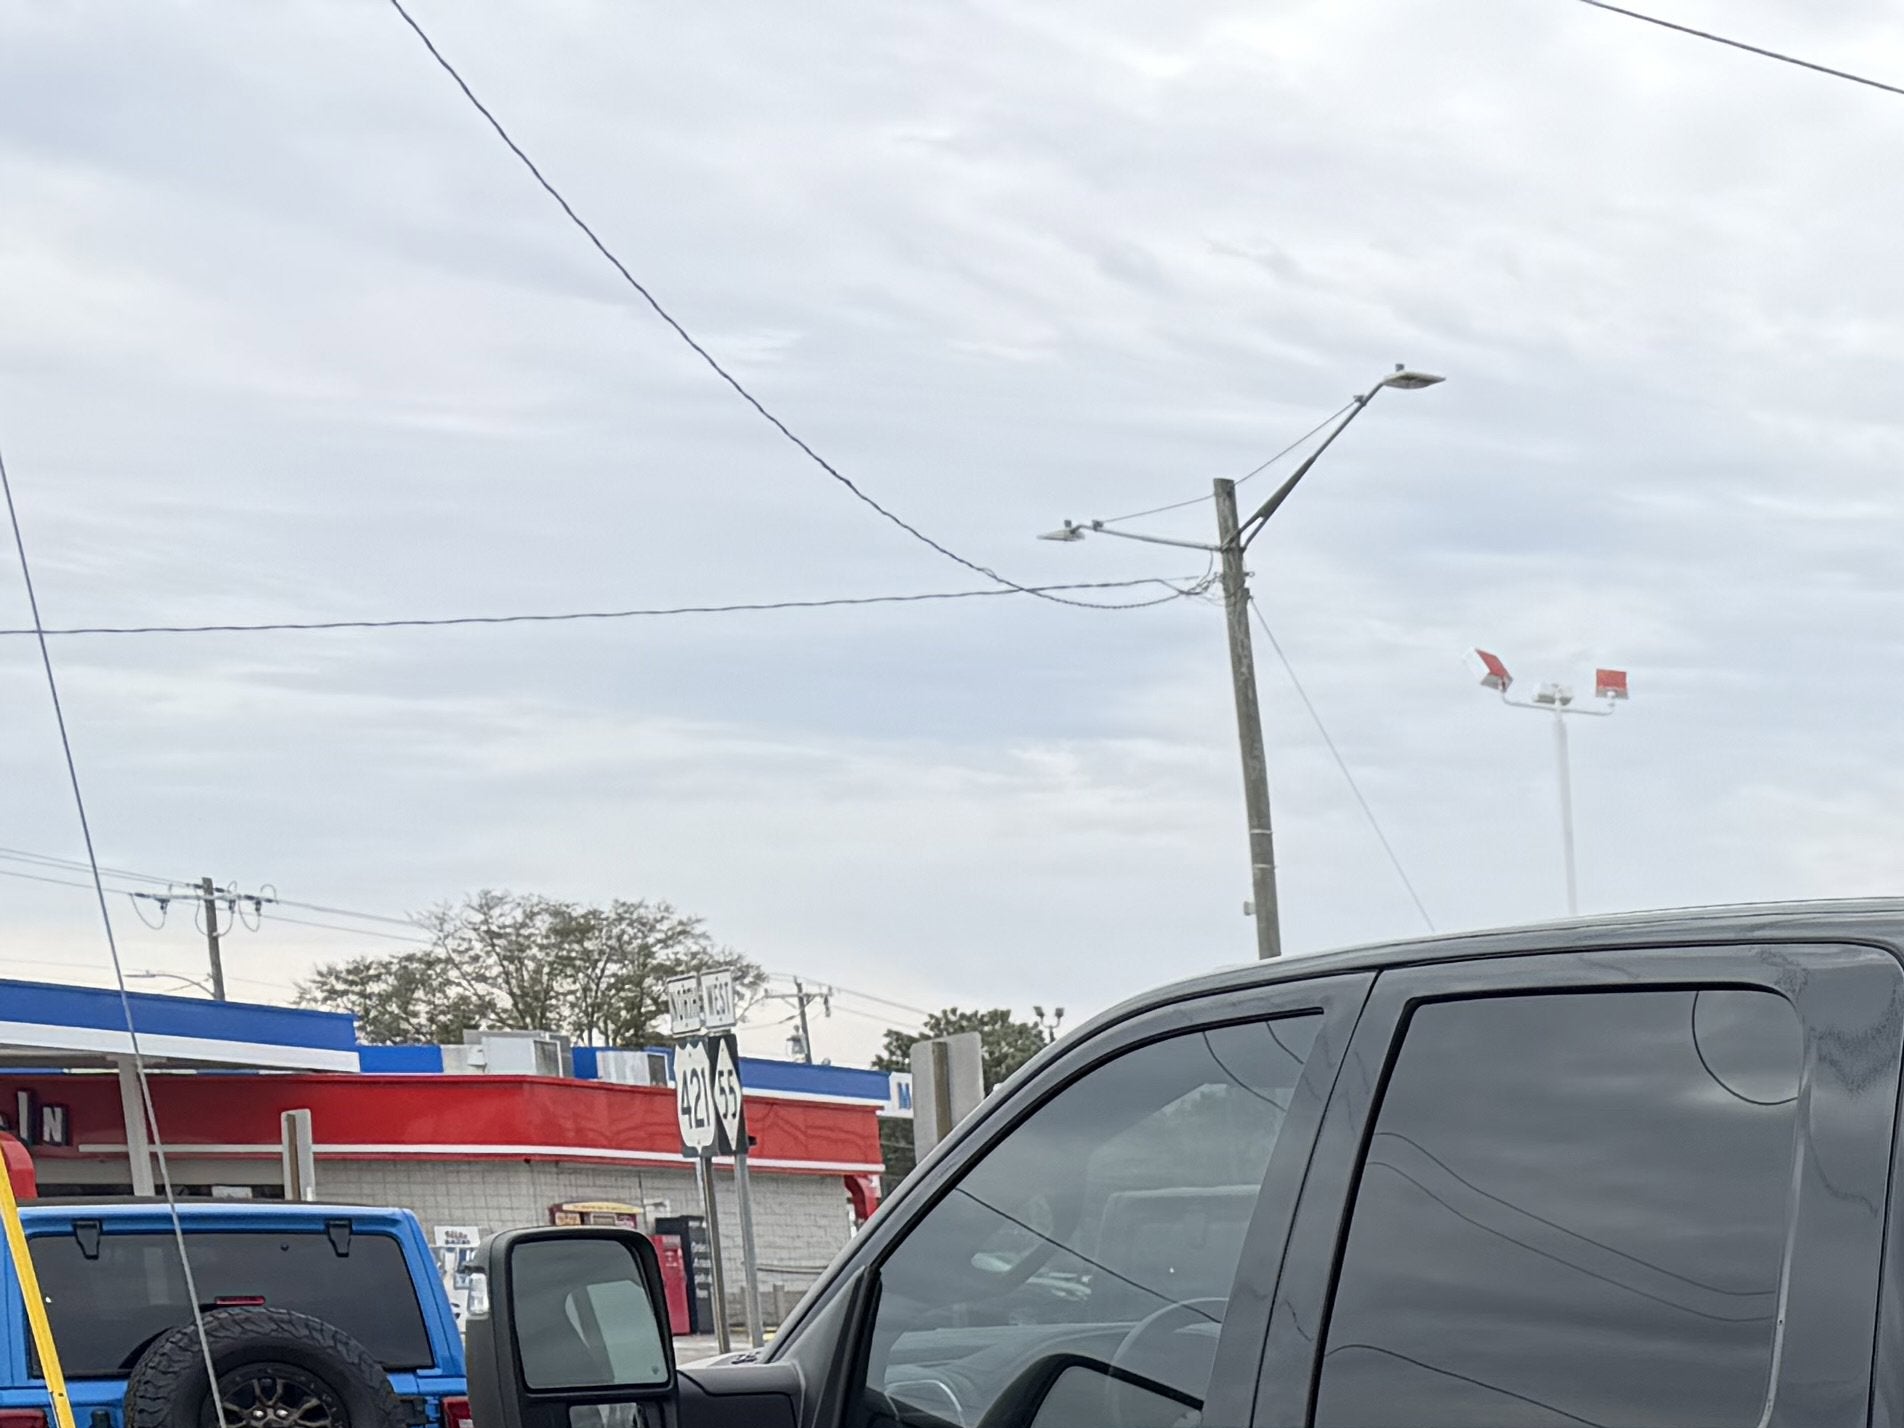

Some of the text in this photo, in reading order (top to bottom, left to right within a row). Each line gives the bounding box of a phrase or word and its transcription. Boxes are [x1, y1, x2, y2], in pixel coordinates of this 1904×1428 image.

[705, 982, 731, 1017] WEST
[681, 1067, 711, 1130] 421
[717, 1069, 737, 1120] 55
